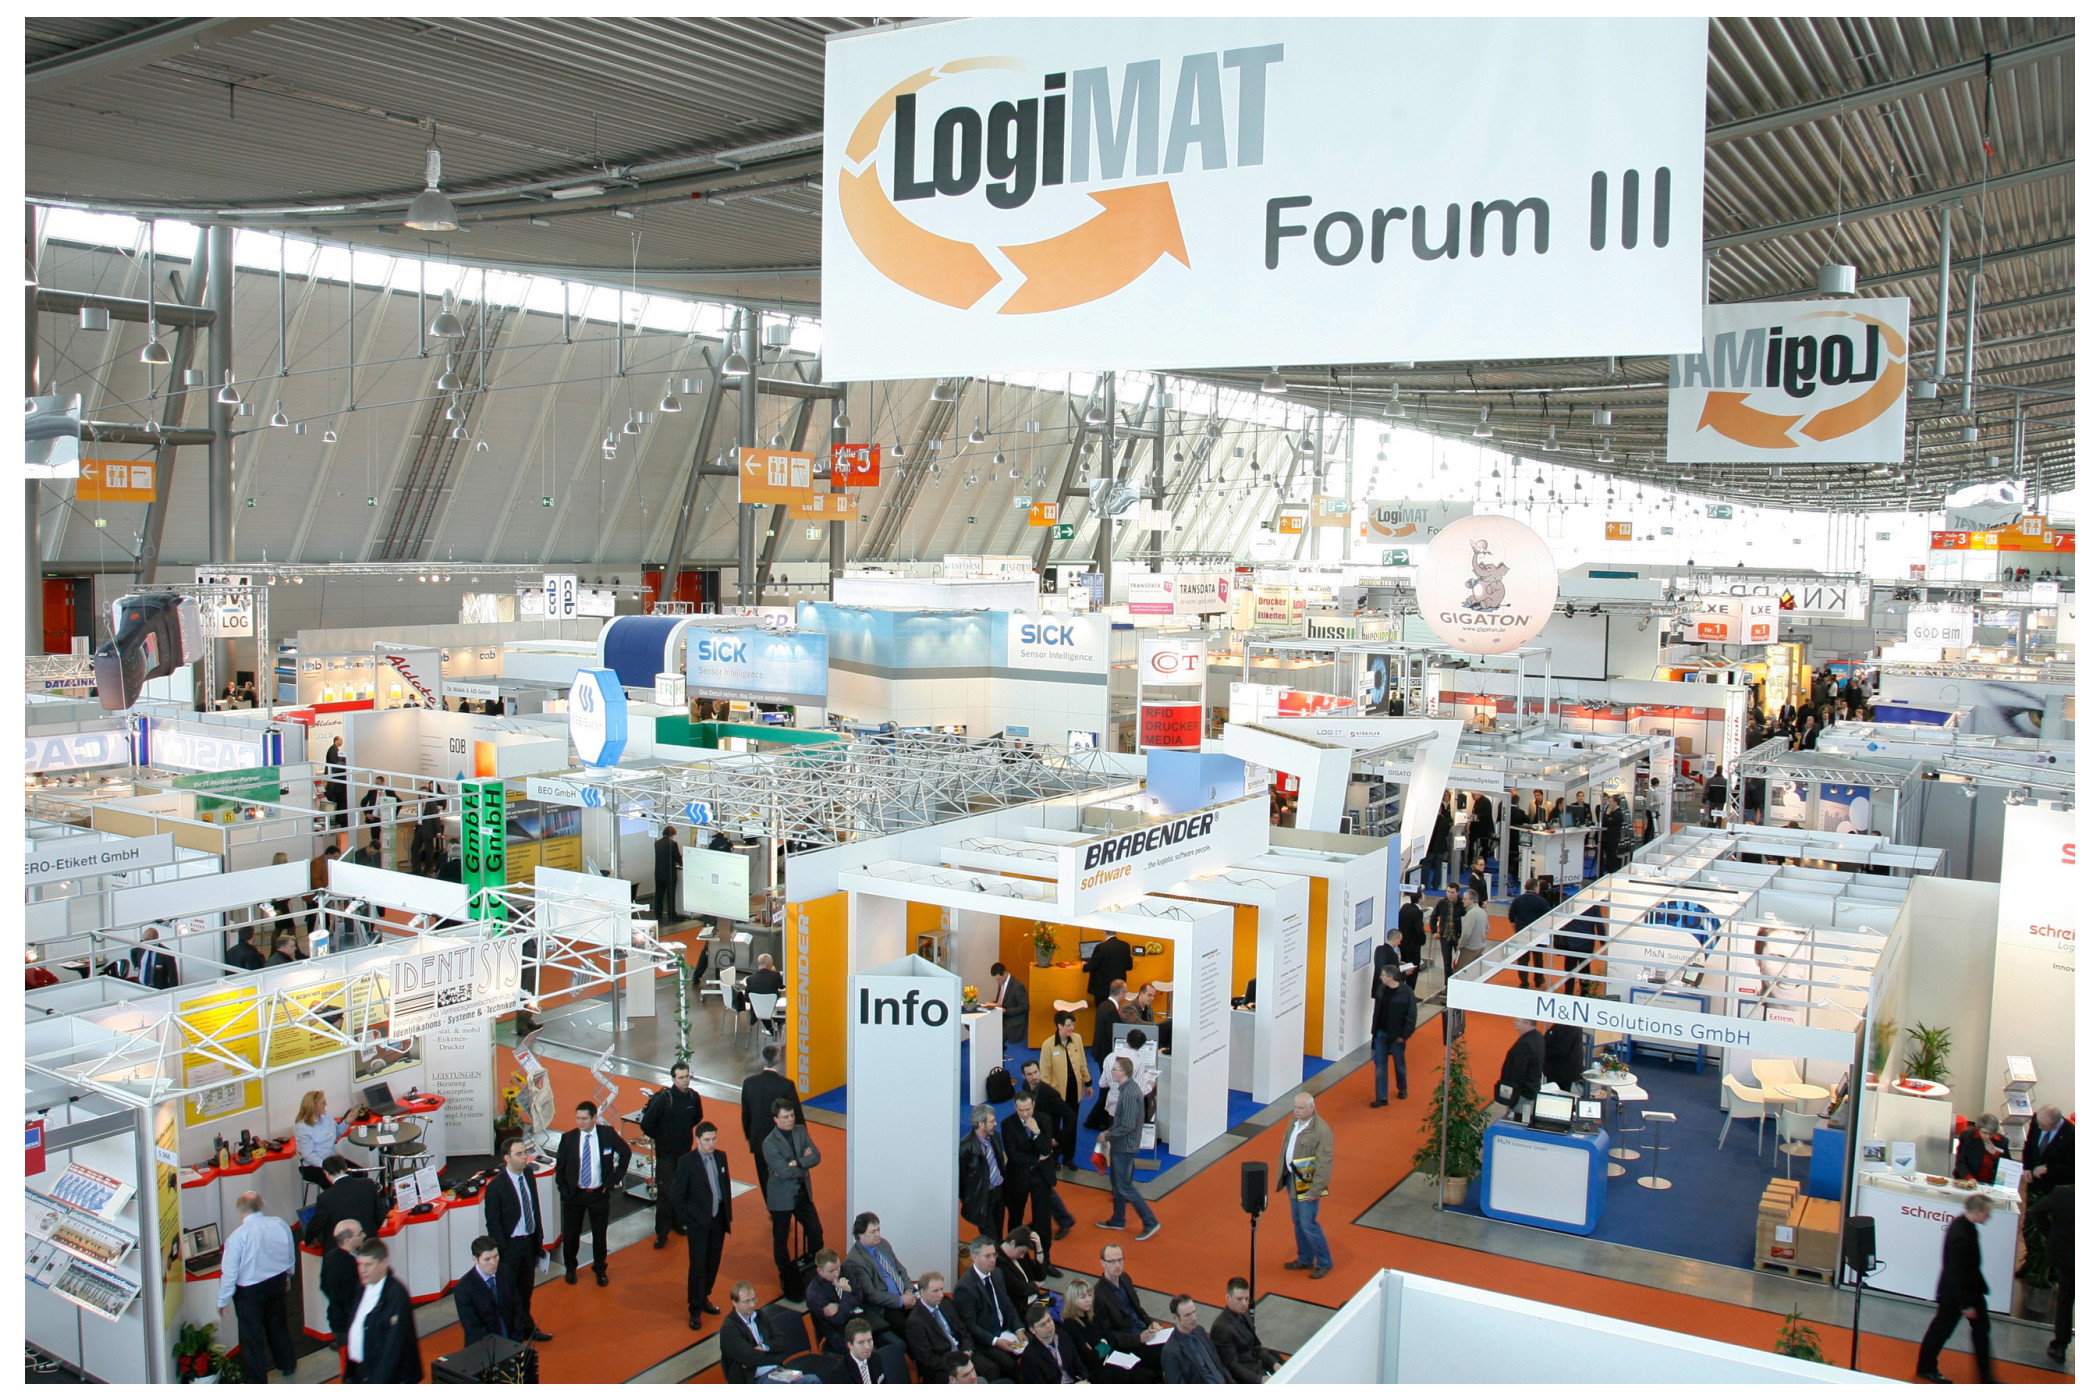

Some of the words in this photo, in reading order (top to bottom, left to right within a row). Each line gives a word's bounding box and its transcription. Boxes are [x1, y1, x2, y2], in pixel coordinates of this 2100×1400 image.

[893, 43, 1284, 210] LogiMAT
[1265, 195, 1550, 271] Forum
[1590, 166, 1672, 252] III
[857, 448, 871, 473] 5
[1377, 508, 1429, 525] LogiMAT
[1957, 533, 1966, 544] 3
[2055, 535, 2064, 547] 7
[1180, 583, 1216, 595] TRANSDATA
[545, 579, 557, 615] cab
[564, 579, 575, 615] cab
[1258, 596, 1287, 606] Drucker
[1257, 611, 1286, 620] Etiketten
[1750, 605, 1772, 616] LXE
[222, 615, 249, 628] LOG
[1020, 624, 1075, 647] SICK
[479, 650, 496, 660] cab
[698, 640, 747, 664] SICK
[1020, 649, 1047, 659] Sensor
[1048, 651, 1096, 662] Intelligence.
[698, 667, 722, 676] Sensor
[723, 668, 766, 680] Intelligence.
[1145, 708, 1174, 718] RFID
[1145, 721, 1199, 732] DRUCKER
[449, 738, 467, 754] GOB
[1145, 735, 1183, 745] MEDIA
[537, 785, 554, 795] BEO
[554, 787, 577, 798] GmbH
[464, 787, 481, 874] GmbH
[484, 789, 503, 873] GmbH
[101, 848, 139, 863] GmbH
[1080, 863, 1132, 891] software
[1644, 948, 1665, 959] M&N
[859, 988, 949, 1027] Info
[393, 1020, 442, 1039] Identifikations
[447, 1011, 476, 1026] Systeme
[476, 1008, 483, 1017] &
[1535, 995, 1590, 1024] M&N
[1596, 1010, 1684, 1037] Solutions
[1690, 1018, 1752, 1046] GmbH
[432, 1071, 482, 1080] LEISTUNGEN
[436, 1080, 466, 1088] Beratung
[437, 1088, 475, 1096] Konzeption
